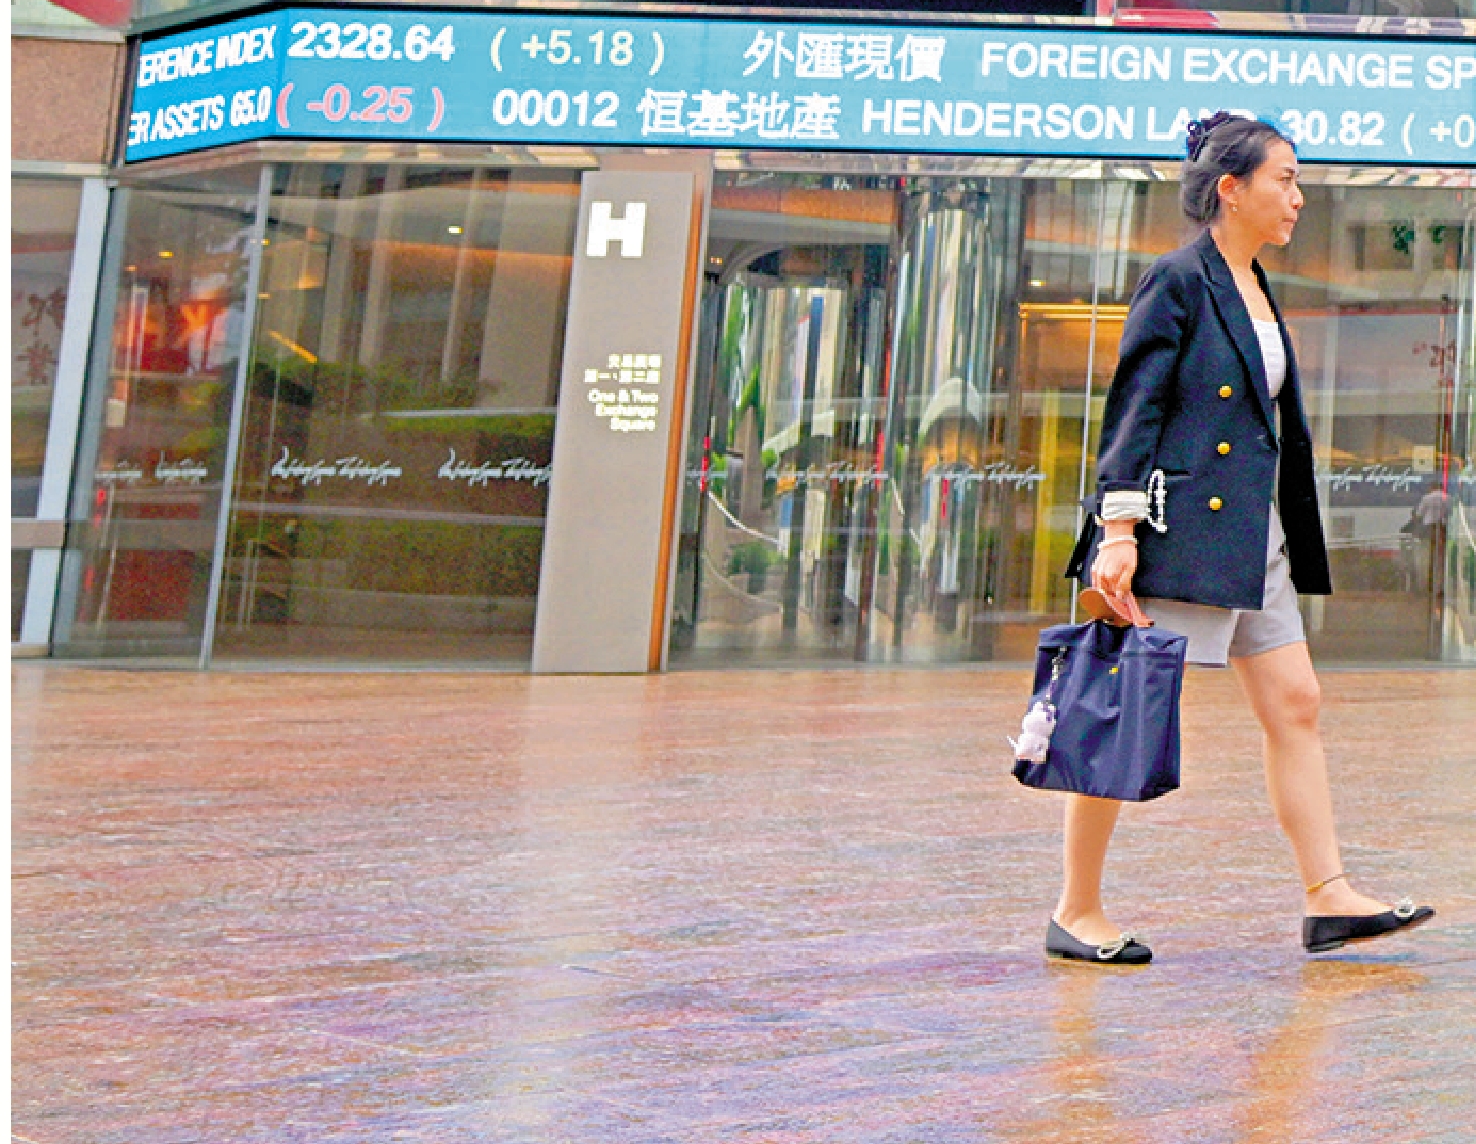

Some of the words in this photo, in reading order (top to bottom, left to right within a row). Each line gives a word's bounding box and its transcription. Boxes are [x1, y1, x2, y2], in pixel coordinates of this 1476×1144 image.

[215, 26, 276, 68] INDEX
[289, 22, 453, 60] 2328.64
[523, 31, 632, 64] +5.18
[744, 31, 945, 81] 外匯現價
[982, 43, 1171, 79] FOREIGN
[1184, 49, 1412, 87] EXCHANGE
[149, 95, 225, 141] ASSETS
[308, 86, 412, 122] -0.25
[494, 90, 618, 126] 00012
[638, 89, 840, 138] 恒基地產
[864, 100, 1133, 139] HENDERSON
[1143, 104, 1257, 142] LA
[1280, 109, 1385, 146] 30.82
[587, 203, 645, 256] H
